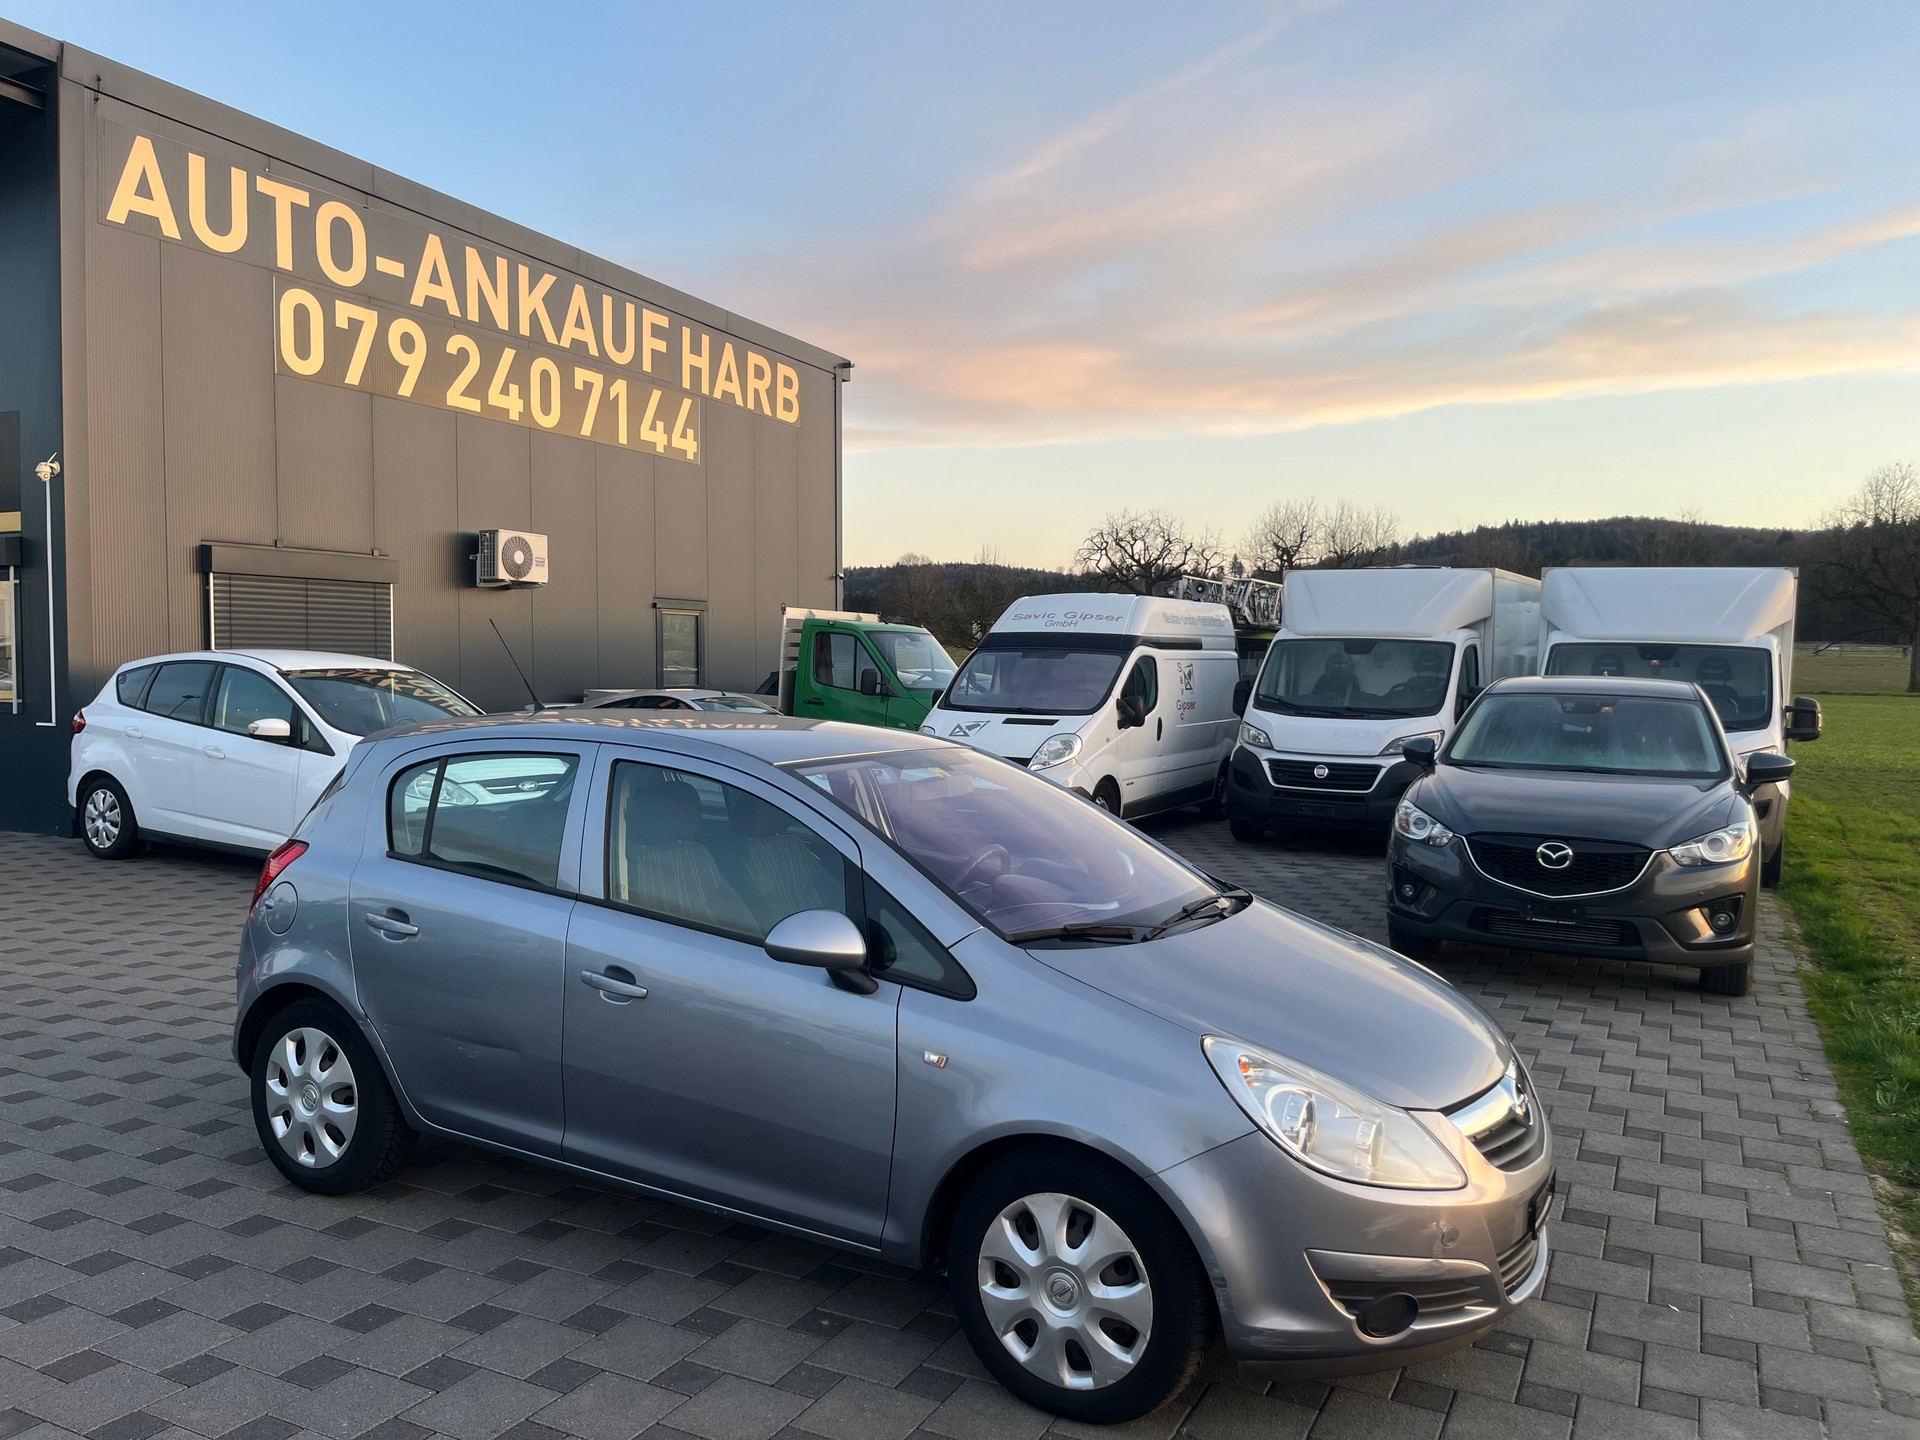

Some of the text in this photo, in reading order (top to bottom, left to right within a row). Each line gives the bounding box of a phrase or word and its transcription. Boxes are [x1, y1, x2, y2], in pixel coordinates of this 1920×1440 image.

[106, 135, 800, 423] AUTO-ANKAUF HARB
[280, 288, 427, 397] 079
[1012, 606, 1124, 622] Savic Gipser
